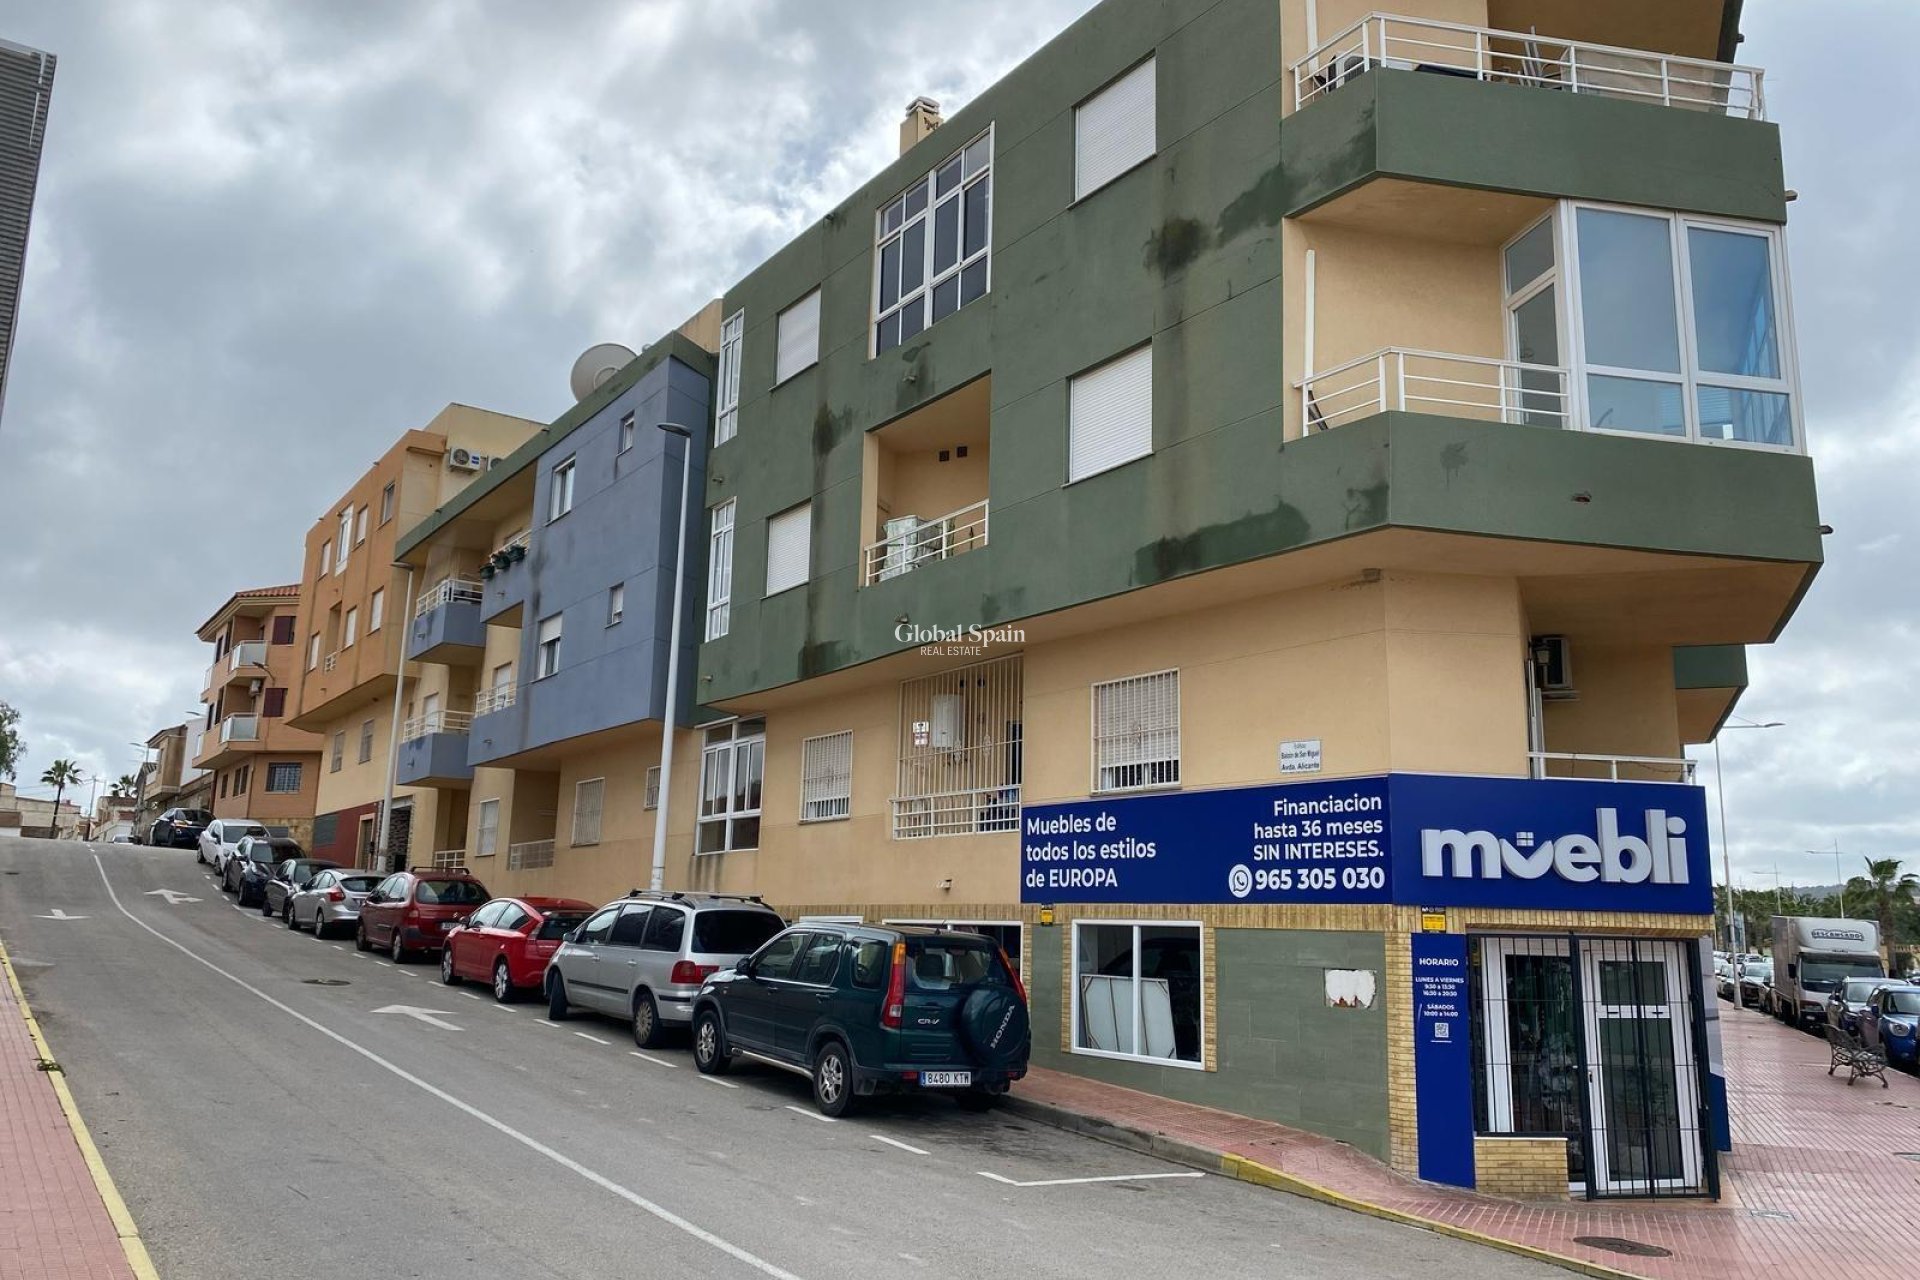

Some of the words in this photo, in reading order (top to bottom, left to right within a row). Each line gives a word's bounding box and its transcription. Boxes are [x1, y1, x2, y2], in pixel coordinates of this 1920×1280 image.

[1273, 793, 1382, 817] Financiacion
[1027, 813, 1092, 836] Muebles
[1095, 811, 1117, 832] de
[1253, 822, 1298, 840] hasta
[1301, 820, 1322, 837] 36
[1326, 819, 1384, 836] meses
[1025, 840, 1069, 862] todos
[1073, 840, 1097, 860] los
[1099, 837, 1157, 860] estilos
[1253, 843, 1280, 861] SIN
[1284, 839, 1385, 860] INTERESES.
[1421, 807, 1690, 884] muebli
[1025, 868, 1045, 888] de
[1049, 867, 1118, 888] EUROPA
[1254, 868, 1293, 890] 965
[1296, 867, 1337, 890] 305
[1342, 866, 1385, 890] 030
[1419, 958, 1459, 966] HORARIO
[990, 1004, 1016, 1049] HONDA
[927, 1072, 950, 1084] 8480
